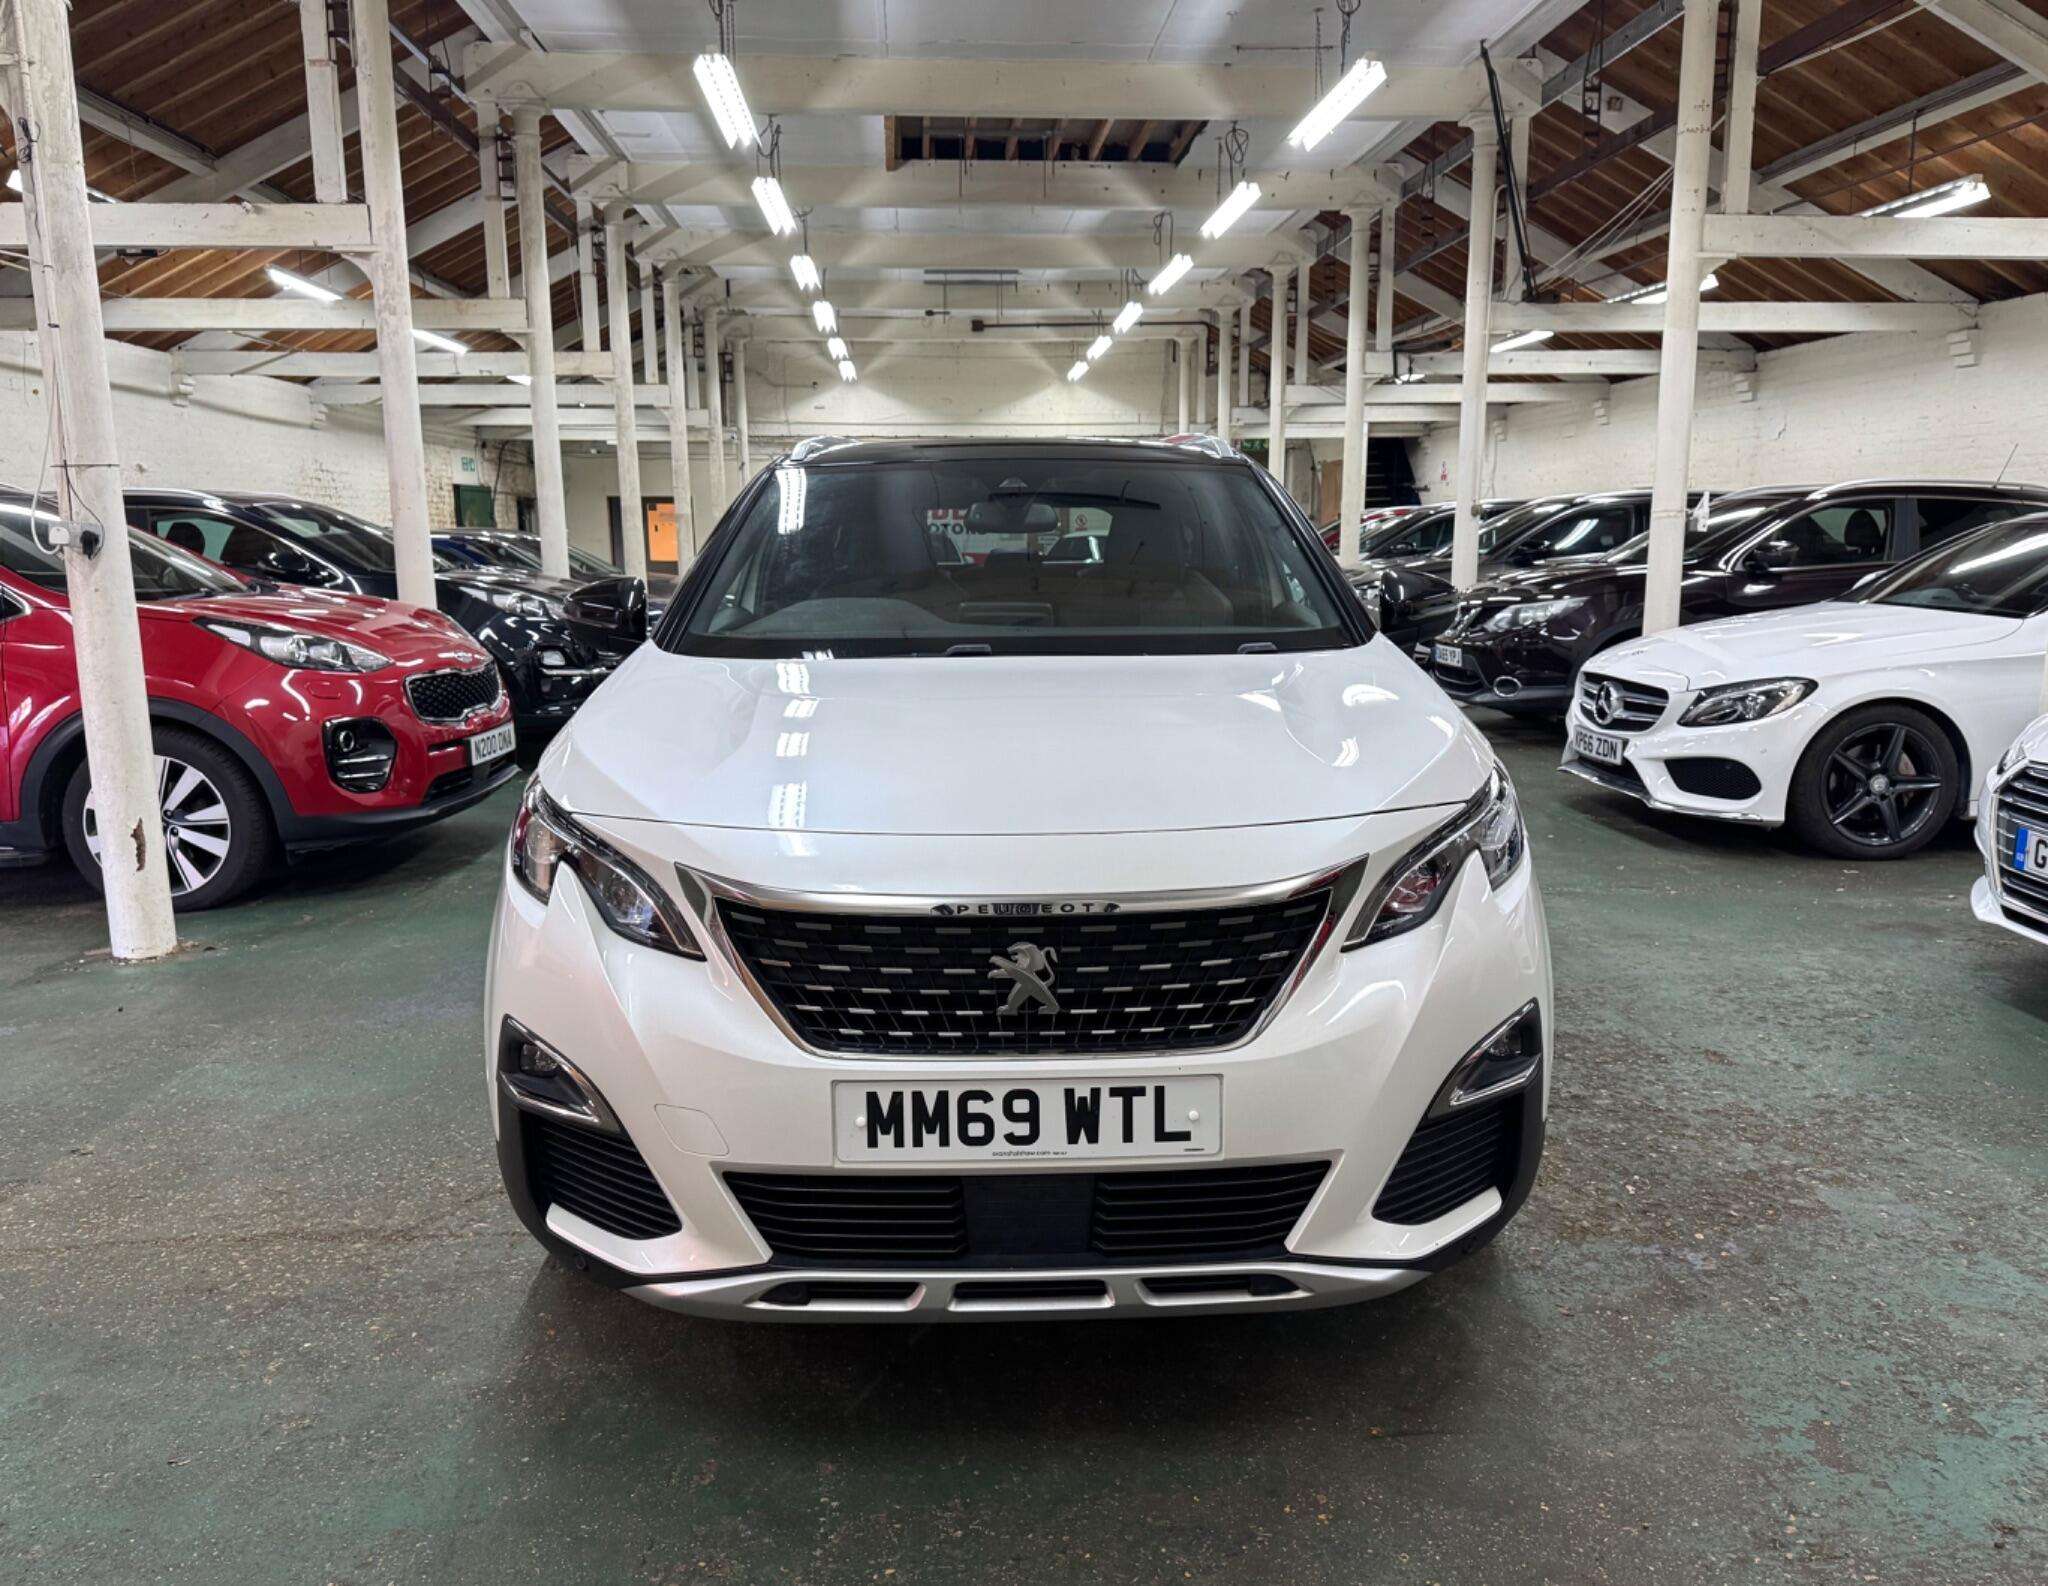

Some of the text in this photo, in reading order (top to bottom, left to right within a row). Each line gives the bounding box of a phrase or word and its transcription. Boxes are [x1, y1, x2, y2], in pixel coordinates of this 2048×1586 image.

[1595, 736, 1618, 760] ZDN
[957, 903, 1095, 915] PEUGEOT
[866, 1085, 1192, 1149] MM69 WTL
